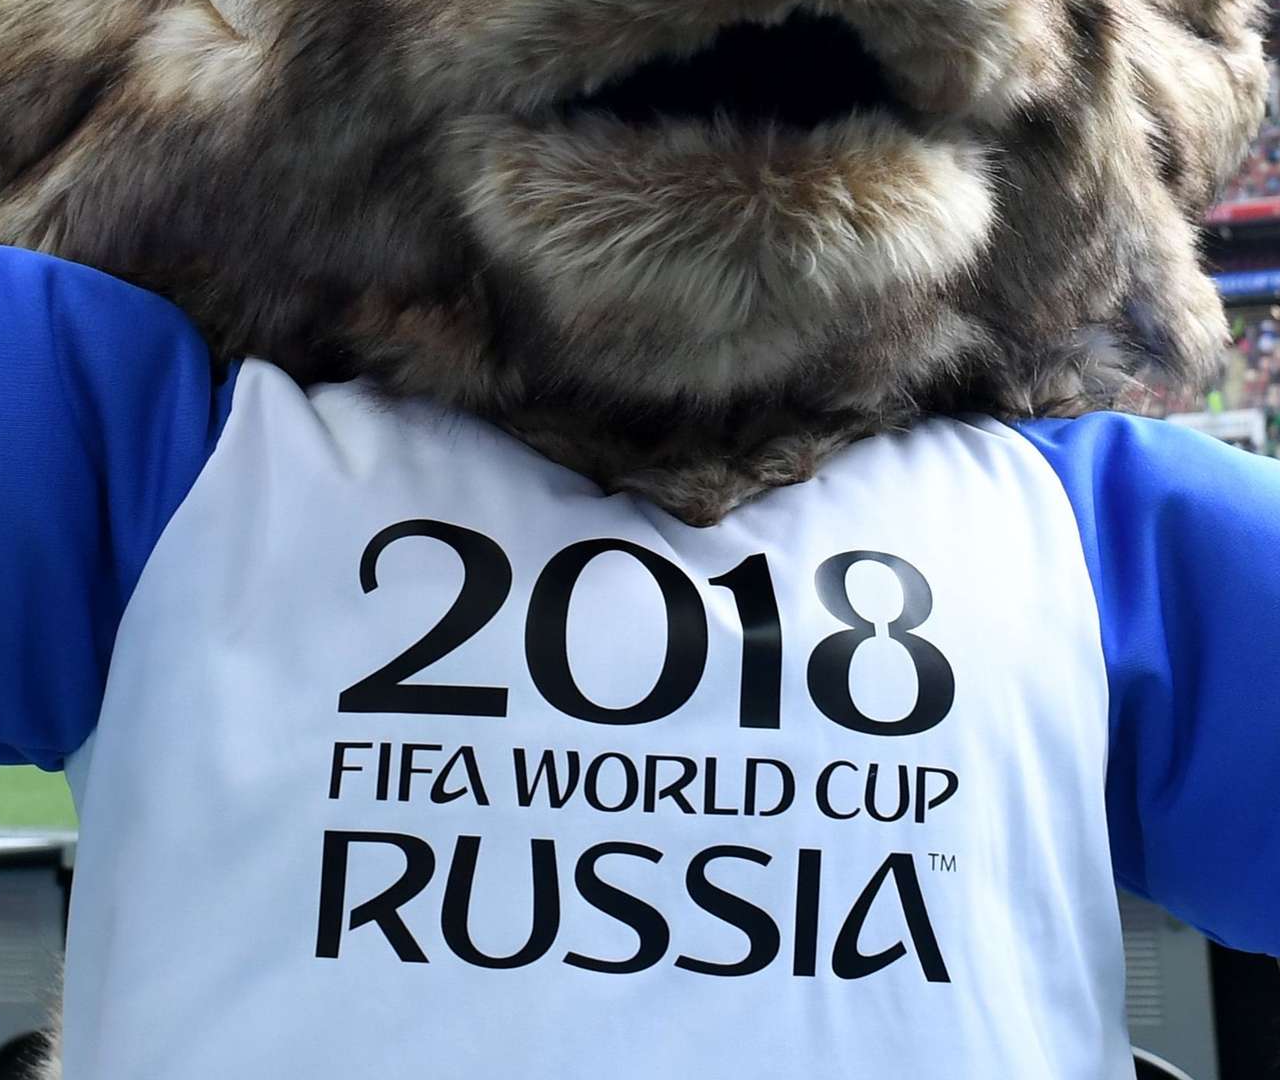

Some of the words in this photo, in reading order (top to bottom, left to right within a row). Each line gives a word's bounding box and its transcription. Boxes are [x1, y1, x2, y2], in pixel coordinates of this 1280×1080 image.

[338, 519, 956, 737] 2018
[328, 741, 490, 807] FIFA
[512, 747, 796, 817] WORLD
[815, 760, 959, 824] CUP
[315, 829, 952, 984] RUSSIA
